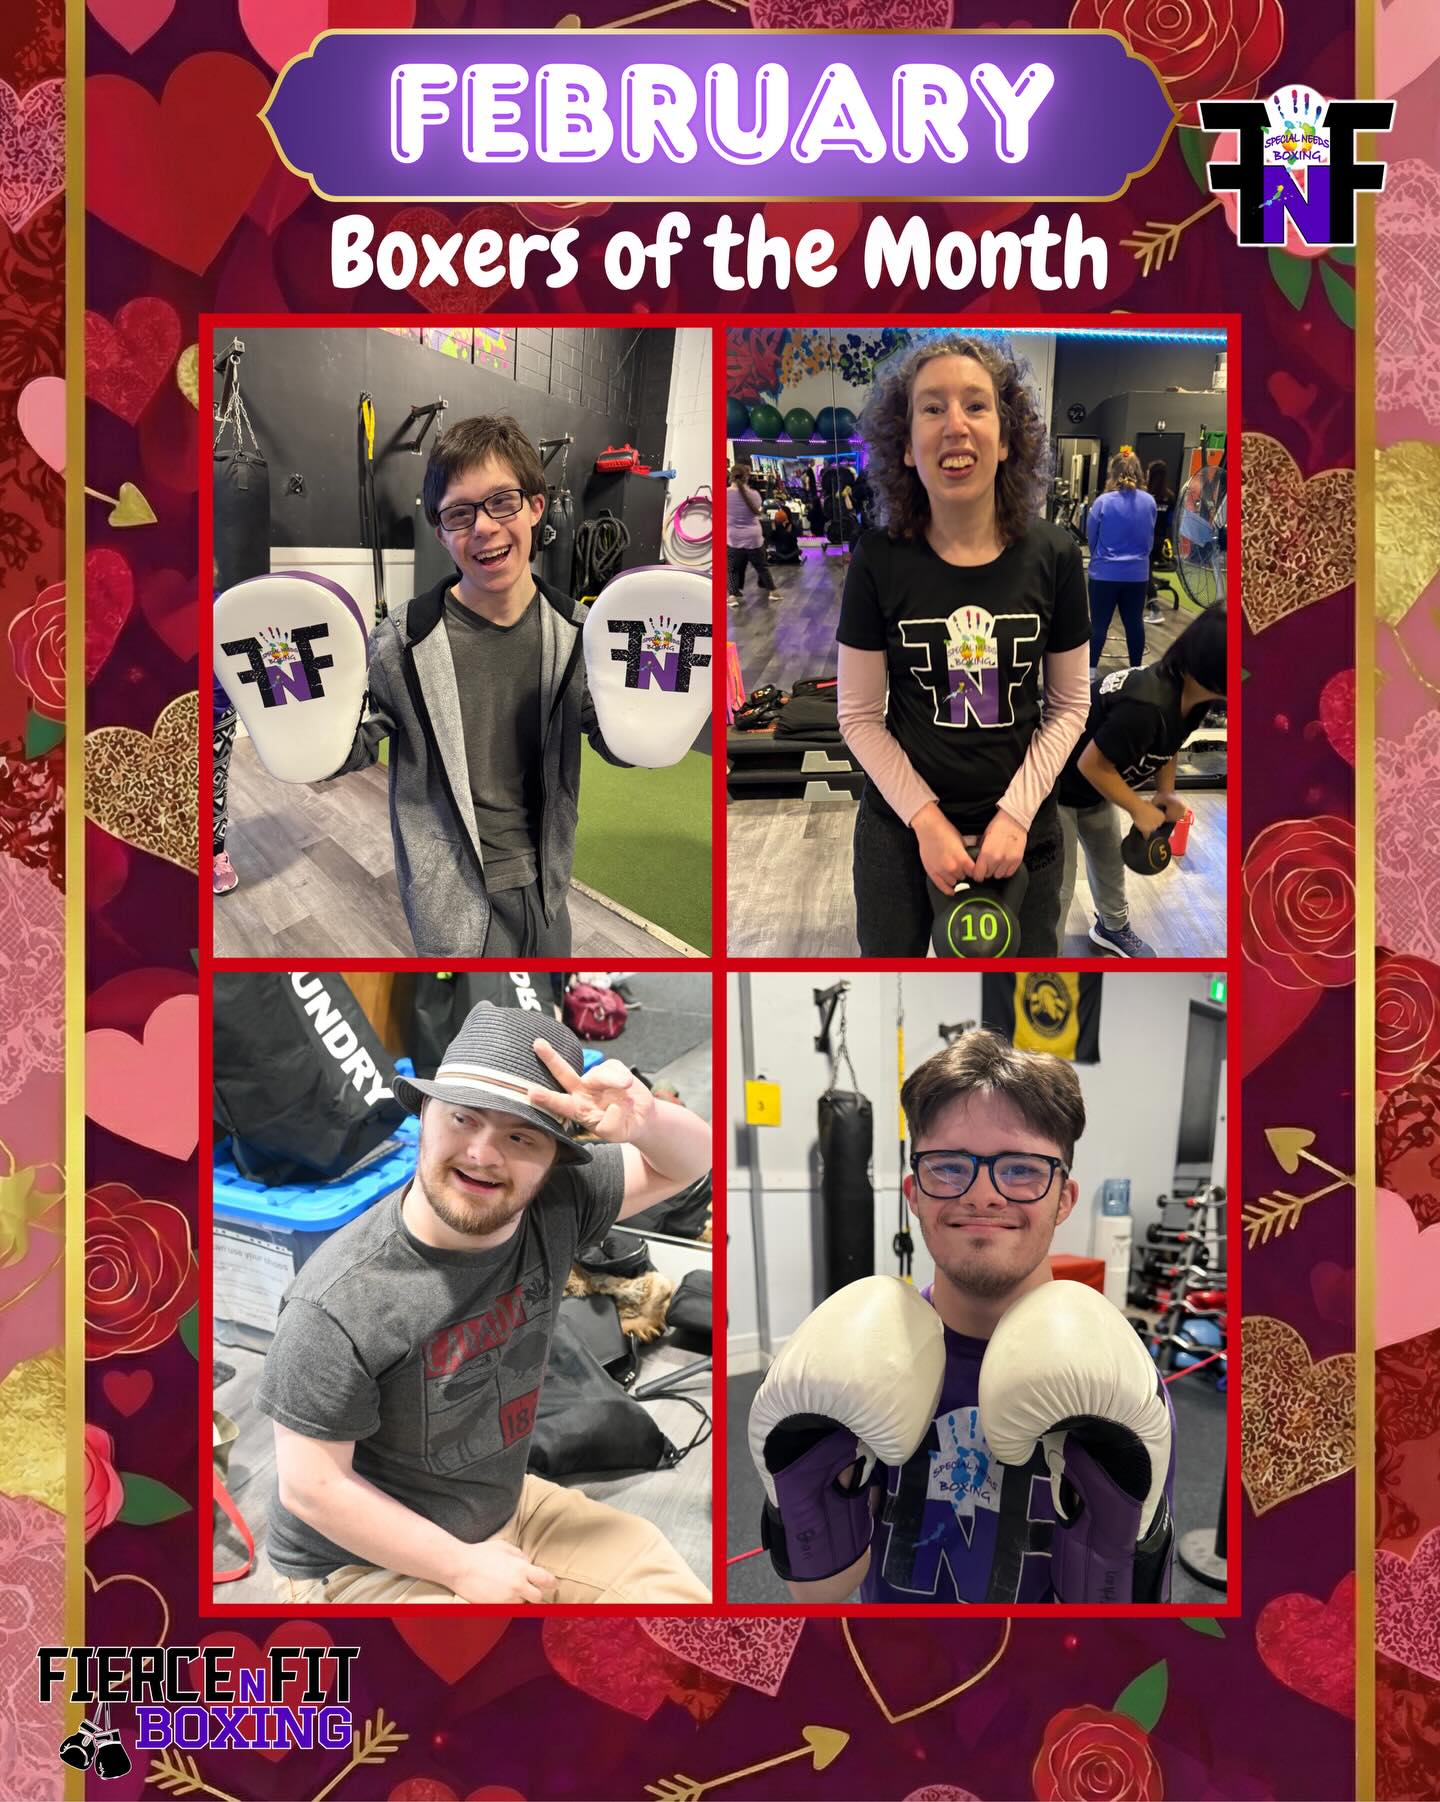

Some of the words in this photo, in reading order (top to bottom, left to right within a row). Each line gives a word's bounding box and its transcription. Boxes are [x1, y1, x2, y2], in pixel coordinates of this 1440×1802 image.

[1159, 844, 1168, 861] 5
[961, 913, 998, 941] 10
[428, 1287, 527, 1373] CANADA
[933, 1457, 975, 1478] SPECIAL
[939, 1480, 991, 1504] BOXING
